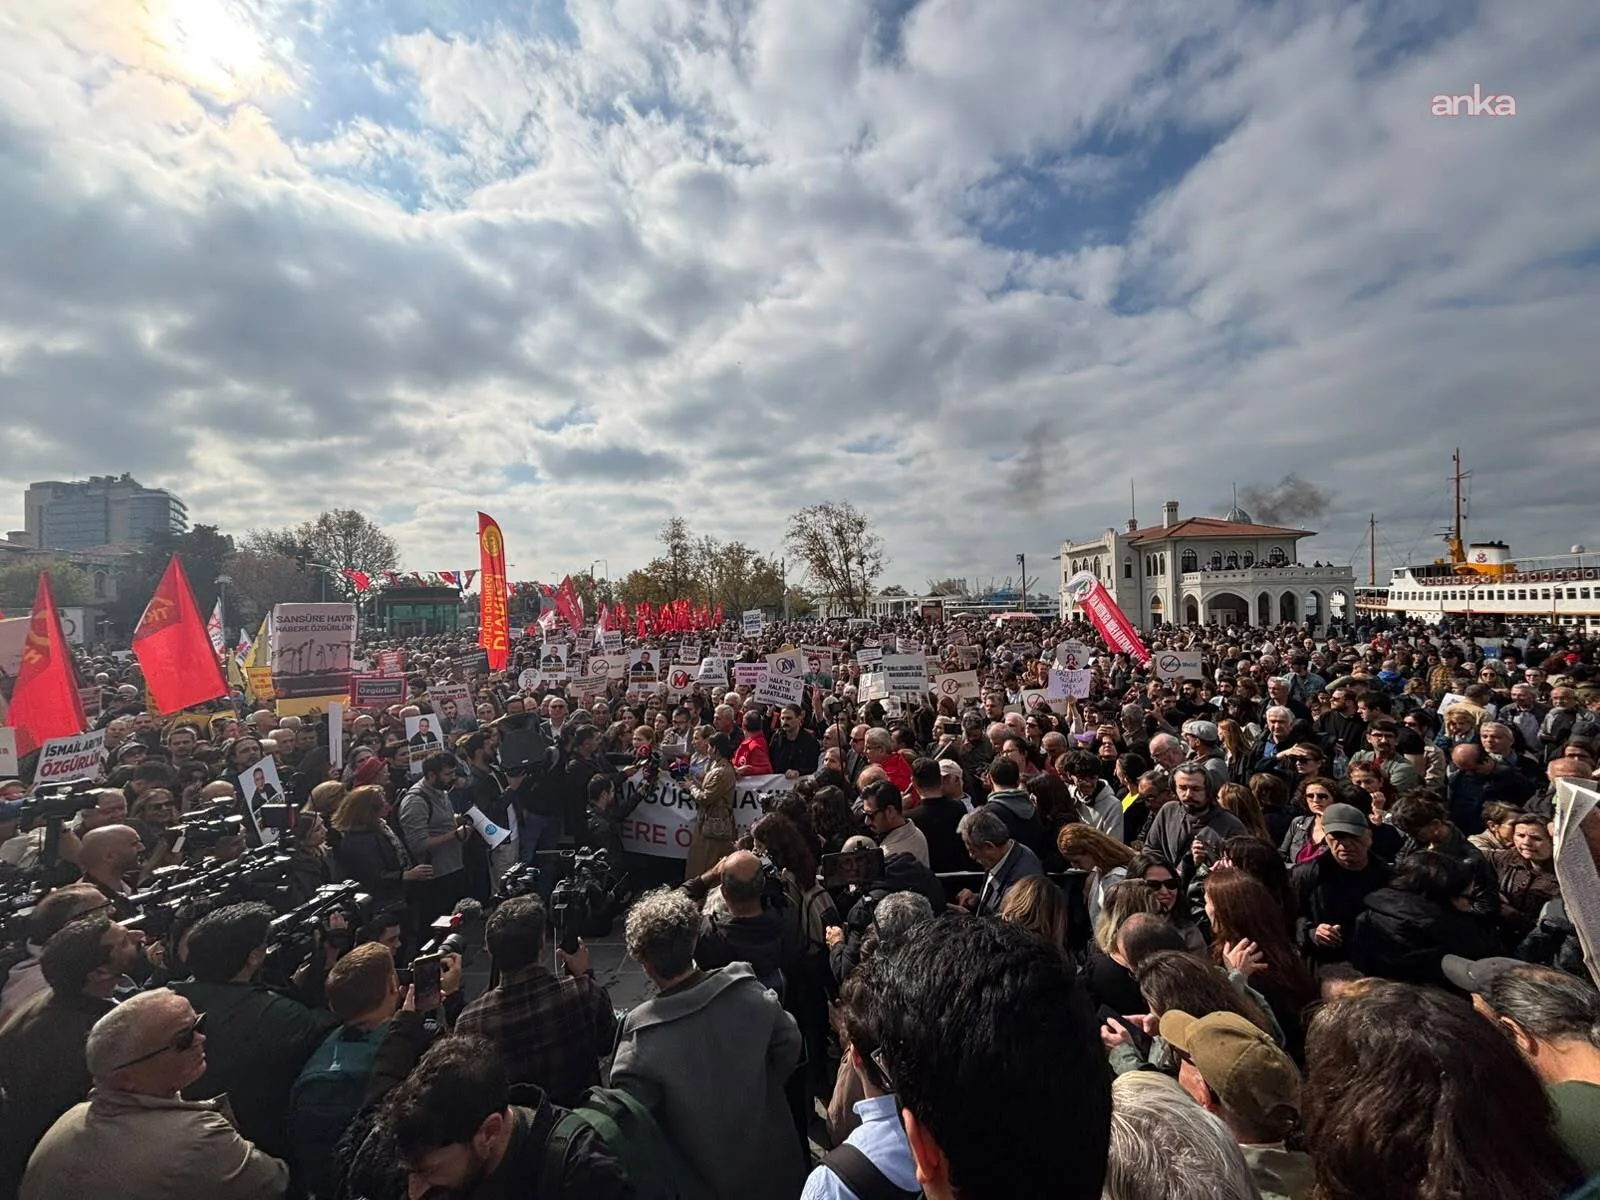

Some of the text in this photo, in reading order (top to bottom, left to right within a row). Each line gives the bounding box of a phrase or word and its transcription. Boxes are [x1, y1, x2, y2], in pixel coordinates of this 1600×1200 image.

[276, 613, 355, 623] SANSÜRE HAYIR
[275, 625, 308, 633] HABERE
[44, 740, 81, 757] İSMAİL
